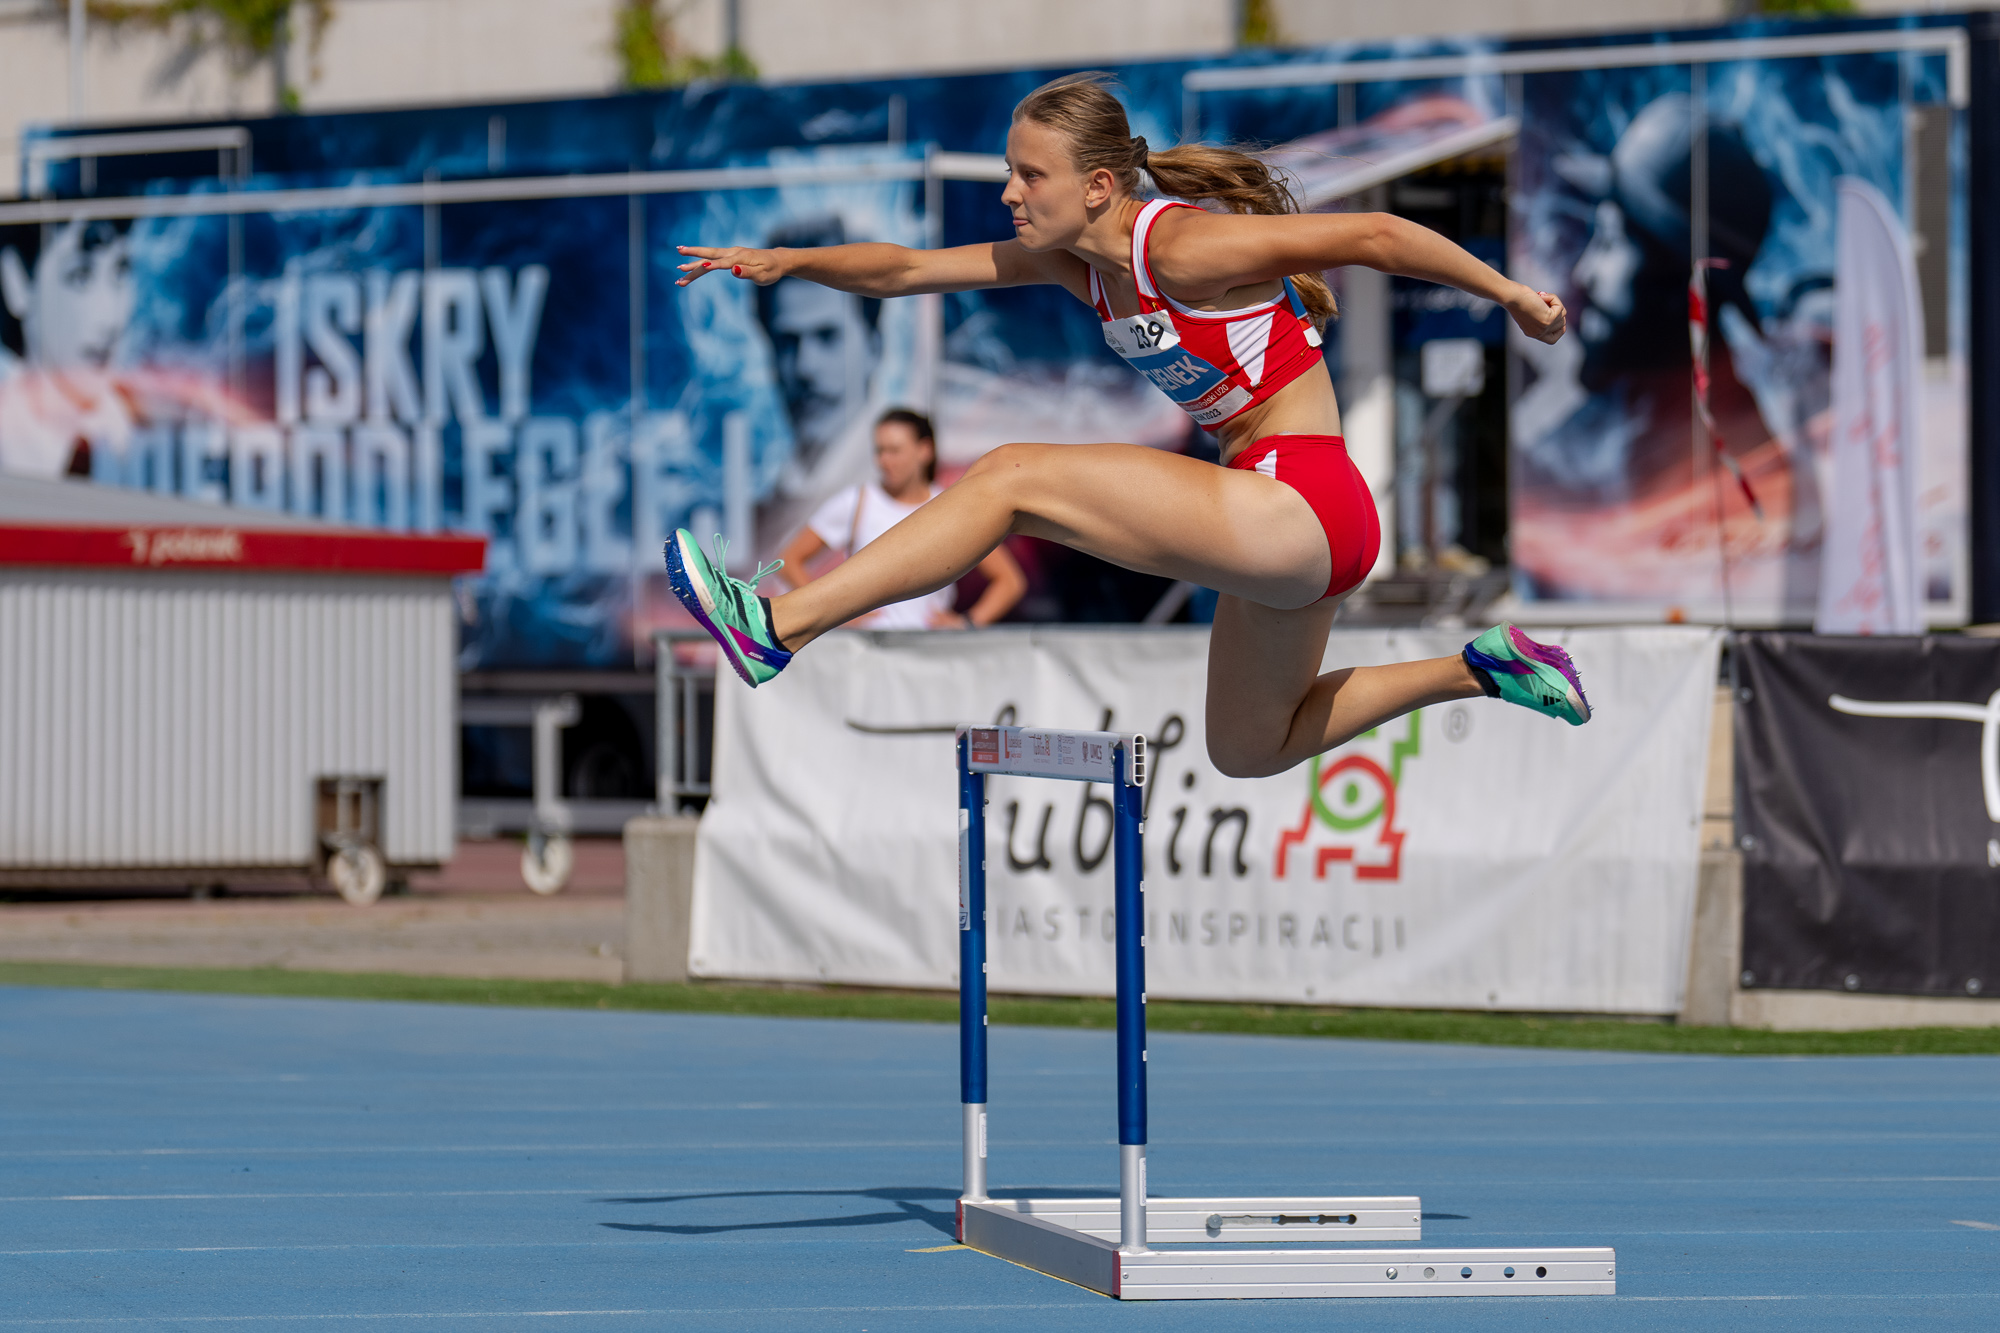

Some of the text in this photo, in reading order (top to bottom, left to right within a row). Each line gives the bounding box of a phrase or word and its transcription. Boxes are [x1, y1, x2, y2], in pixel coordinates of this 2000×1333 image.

[276, 263, 549, 426] ISKRY
[1129, 321, 1164, 349] 239
[1215, 384, 1229, 396] U20
[1148, 909, 1407, 958] INSPIRACJI
